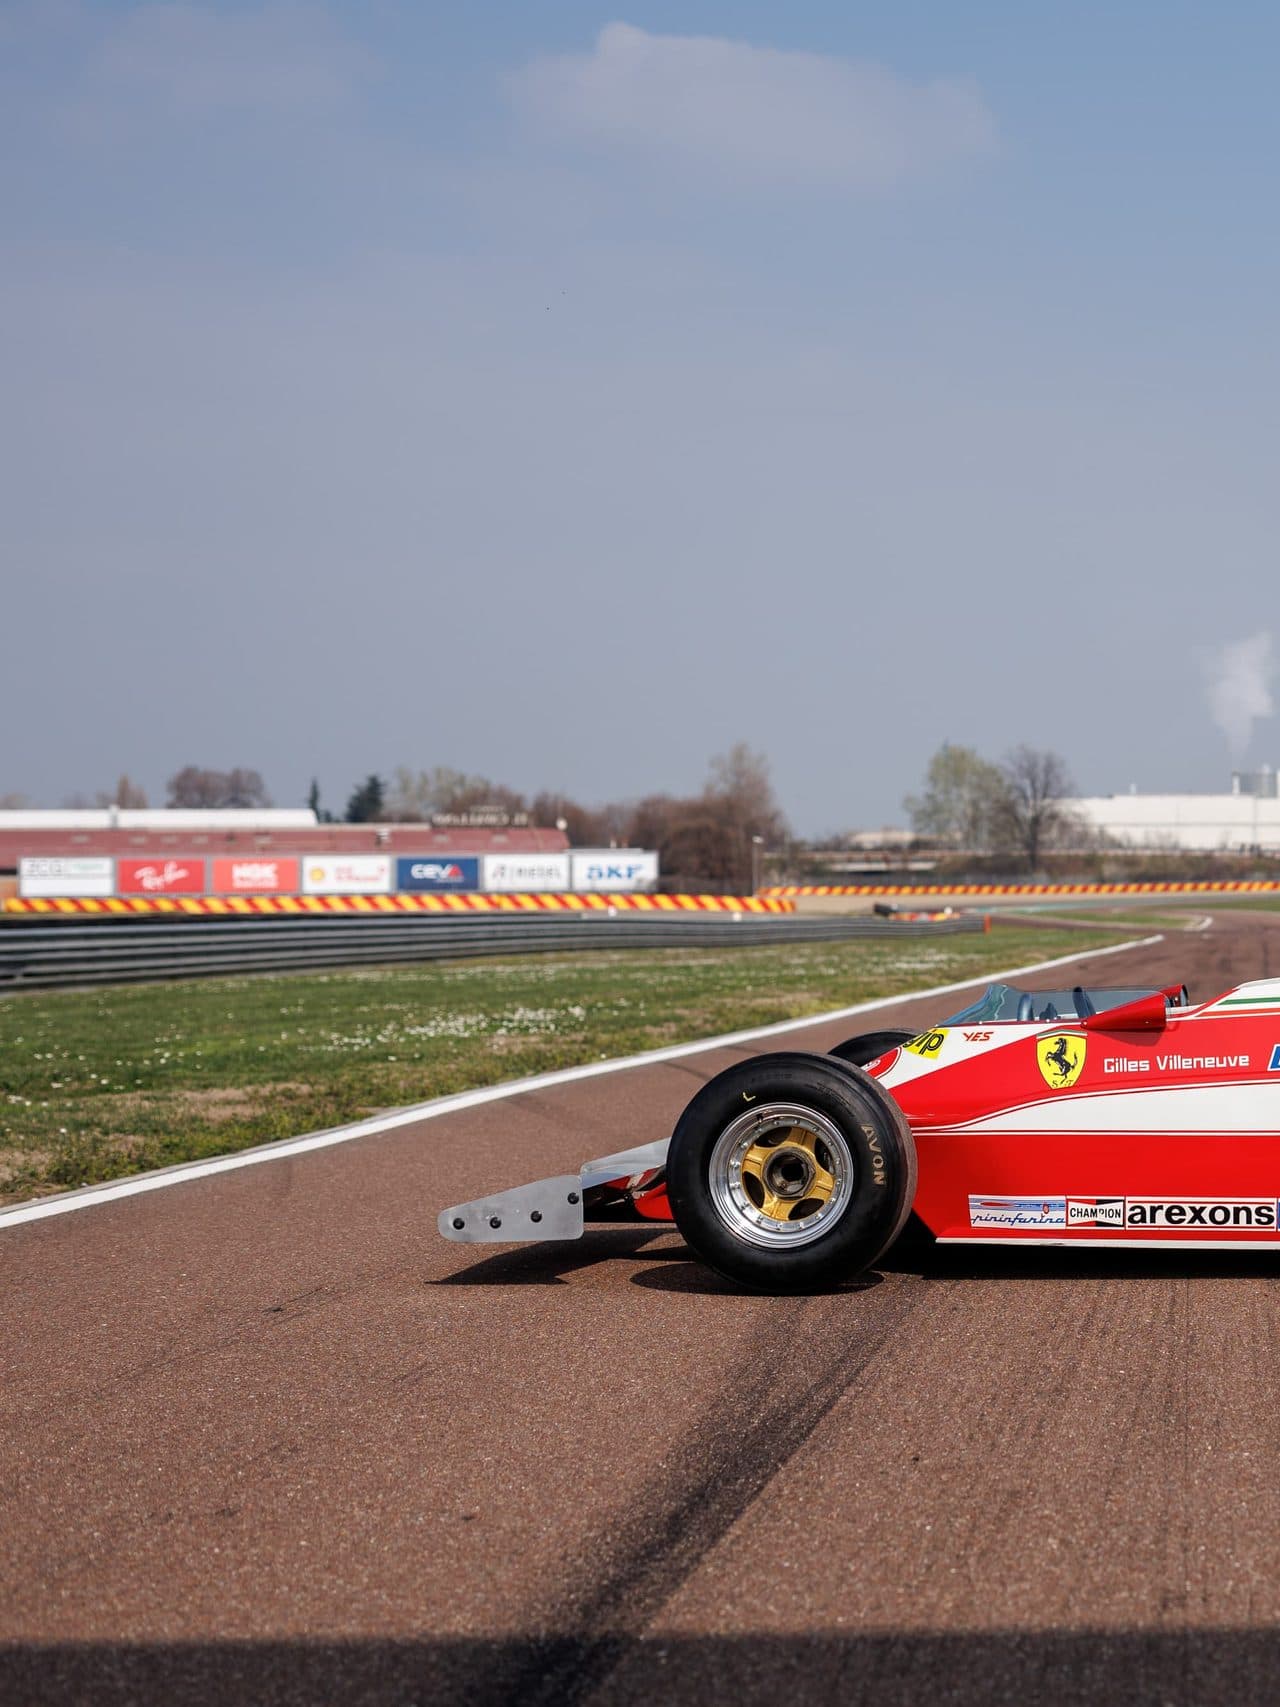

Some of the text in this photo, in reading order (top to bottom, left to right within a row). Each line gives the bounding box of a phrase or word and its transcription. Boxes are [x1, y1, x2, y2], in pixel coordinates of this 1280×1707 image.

[963, 1031, 994, 1042] YES
[1103, 1054, 1250, 1073] Gilles Villeneuve
[861, 1124, 887, 1186] AVON
[971, 1212, 1066, 1226] pininfarina
[1069, 1207, 1121, 1219] CHAMPION
[1127, 1203, 1275, 1226] arexons
